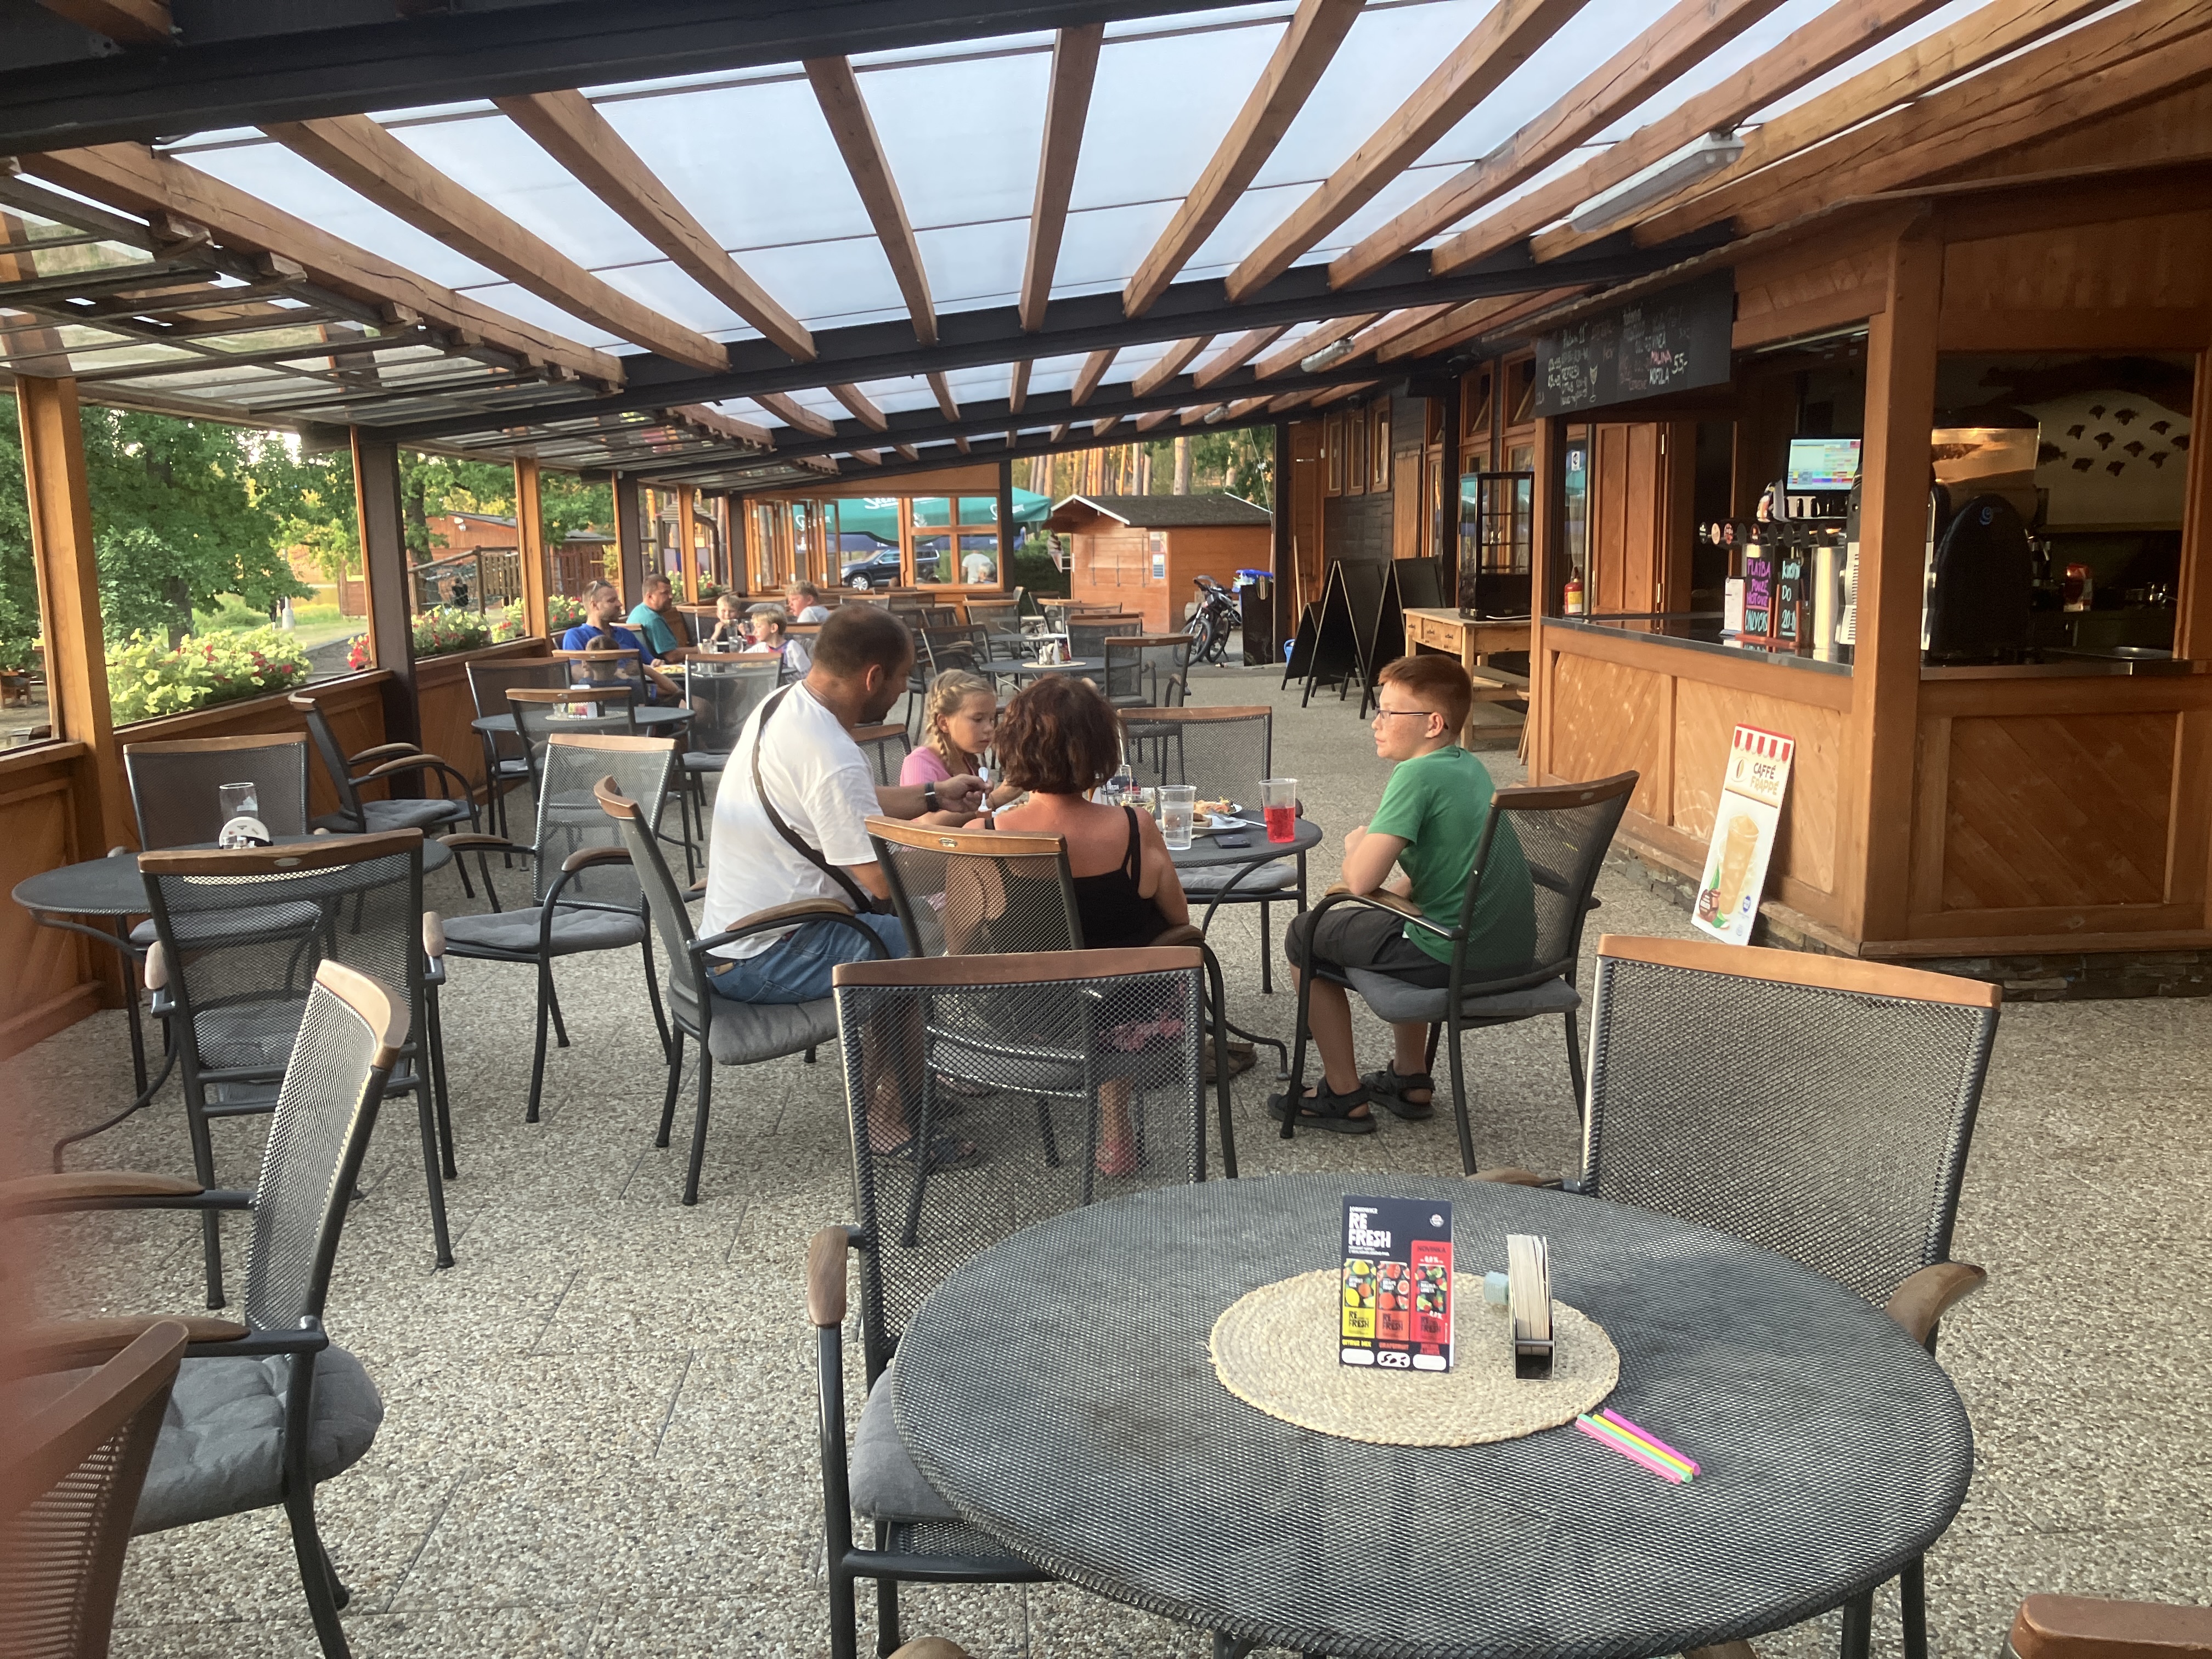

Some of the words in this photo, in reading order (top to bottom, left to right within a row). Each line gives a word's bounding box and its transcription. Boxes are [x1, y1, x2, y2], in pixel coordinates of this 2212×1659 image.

[1747, 558, 1771, 578] PLATBA
[1781, 585, 1792, 602] DO
[1753, 762, 1776, 780] CAFFÉ
[1750, 775, 1780, 795] FRAPPÉ
[1348, 1212, 1368, 1230] RE
[1348, 1228, 1391, 1248] FRESH
[1417, 1245, 1447, 1254] NOVINKA
[1348, 1317, 1369, 1328] FRESH
[1382, 1319, 1403, 1331] FRESH
